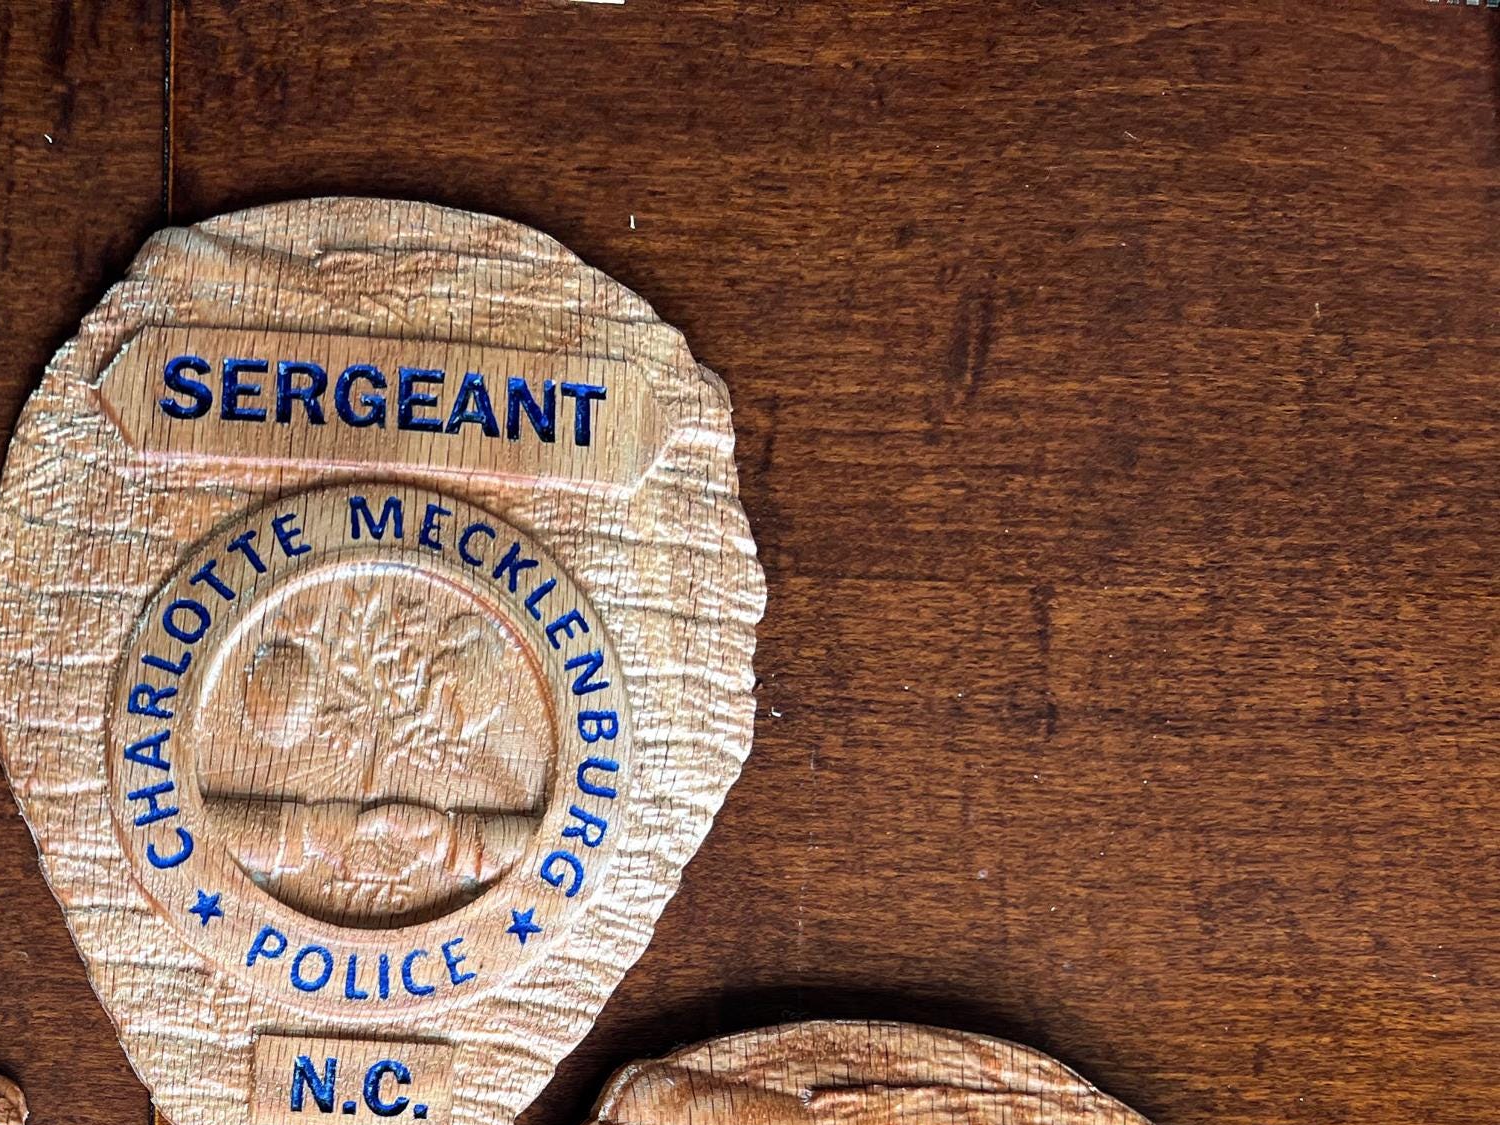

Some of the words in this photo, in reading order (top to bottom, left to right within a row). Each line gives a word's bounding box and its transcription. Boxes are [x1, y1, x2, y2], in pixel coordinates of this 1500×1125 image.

[157, 353, 609, 448] SERGEANT
[123, 513, 312, 871] CHARLOTTE
[348, 495, 625, 899] MECKLENBURG
[244, 923, 478, 1002] POLICE
[288, 1054, 431, 1120] N.C.
